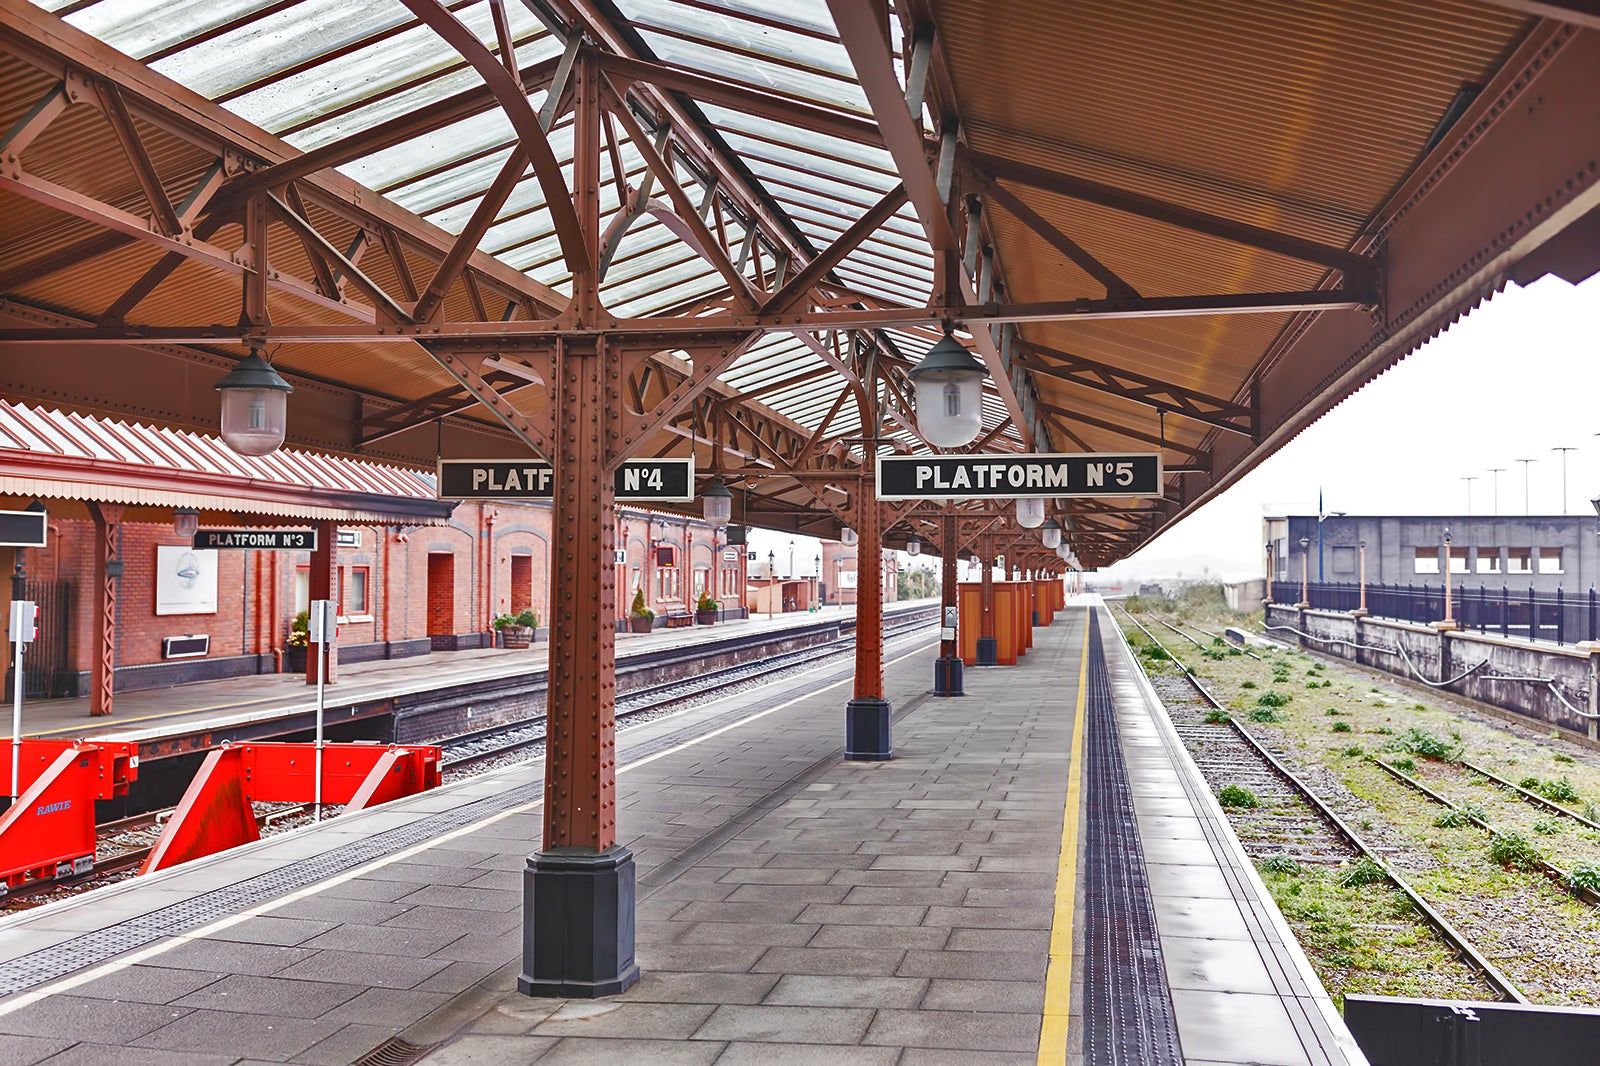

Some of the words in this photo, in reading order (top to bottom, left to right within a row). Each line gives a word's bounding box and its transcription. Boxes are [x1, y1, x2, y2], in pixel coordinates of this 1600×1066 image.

[472, 468, 553, 491] PLATF
[916, 464, 1068, 489] PLATFORM
[209, 534, 276, 546] PLATFORM
